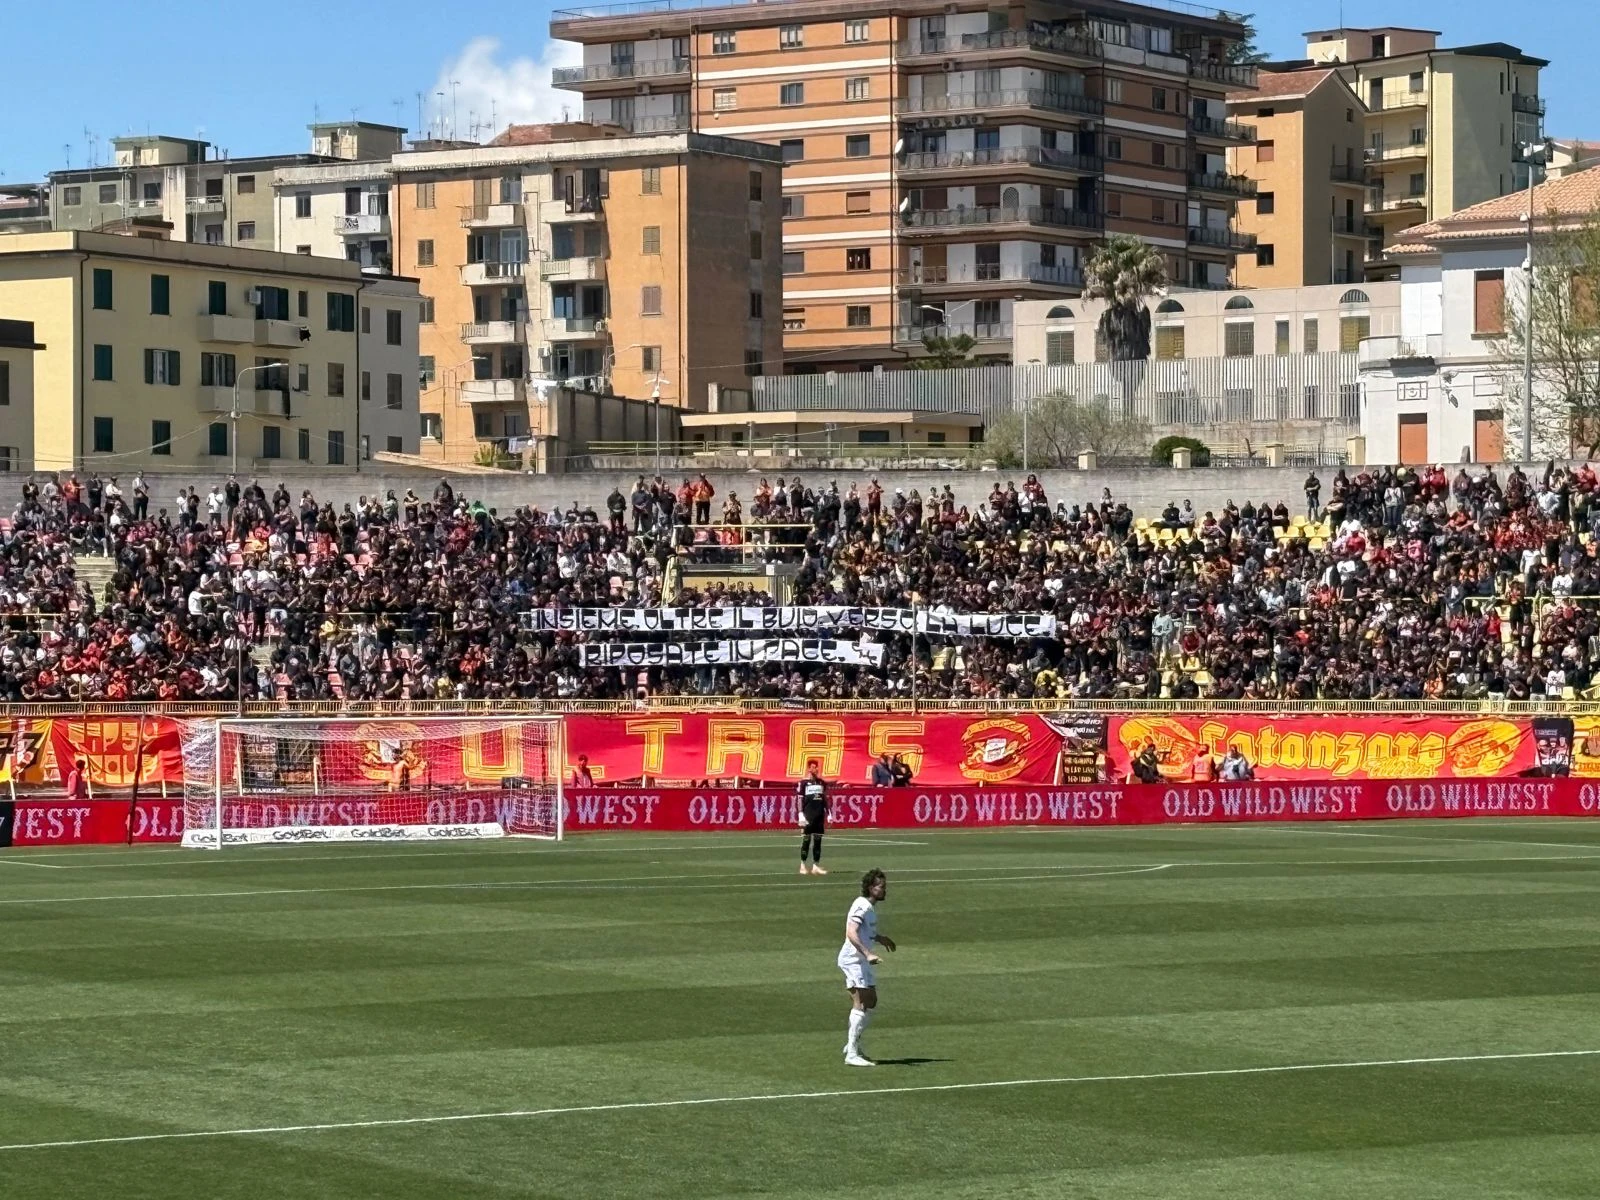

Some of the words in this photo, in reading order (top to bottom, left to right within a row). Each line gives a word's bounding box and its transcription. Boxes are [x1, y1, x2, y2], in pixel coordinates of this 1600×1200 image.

[644, 609, 723, 629] OLTRE
[734, 607, 753, 628] IL
[826, 609, 915, 629] VERSO
[926, 611, 957, 633] LA
[585, 643, 720, 664] RIPOSATE
[729, 639, 754, 662] IN
[576, 796, 660, 824] WEST
[688, 796, 746, 824] OLD
[831, 795, 884, 823] EST
[913, 793, 969, 823] OLD
[974, 792, 1043, 822] WILD
[1048, 790, 1123, 821] WEST
[1163, 789, 1215, 817] OLD
[1221, 787, 1286, 816] WILD
[1291, 786, 1362, 814] WEST
[1386, 784, 1436, 811] OLD
